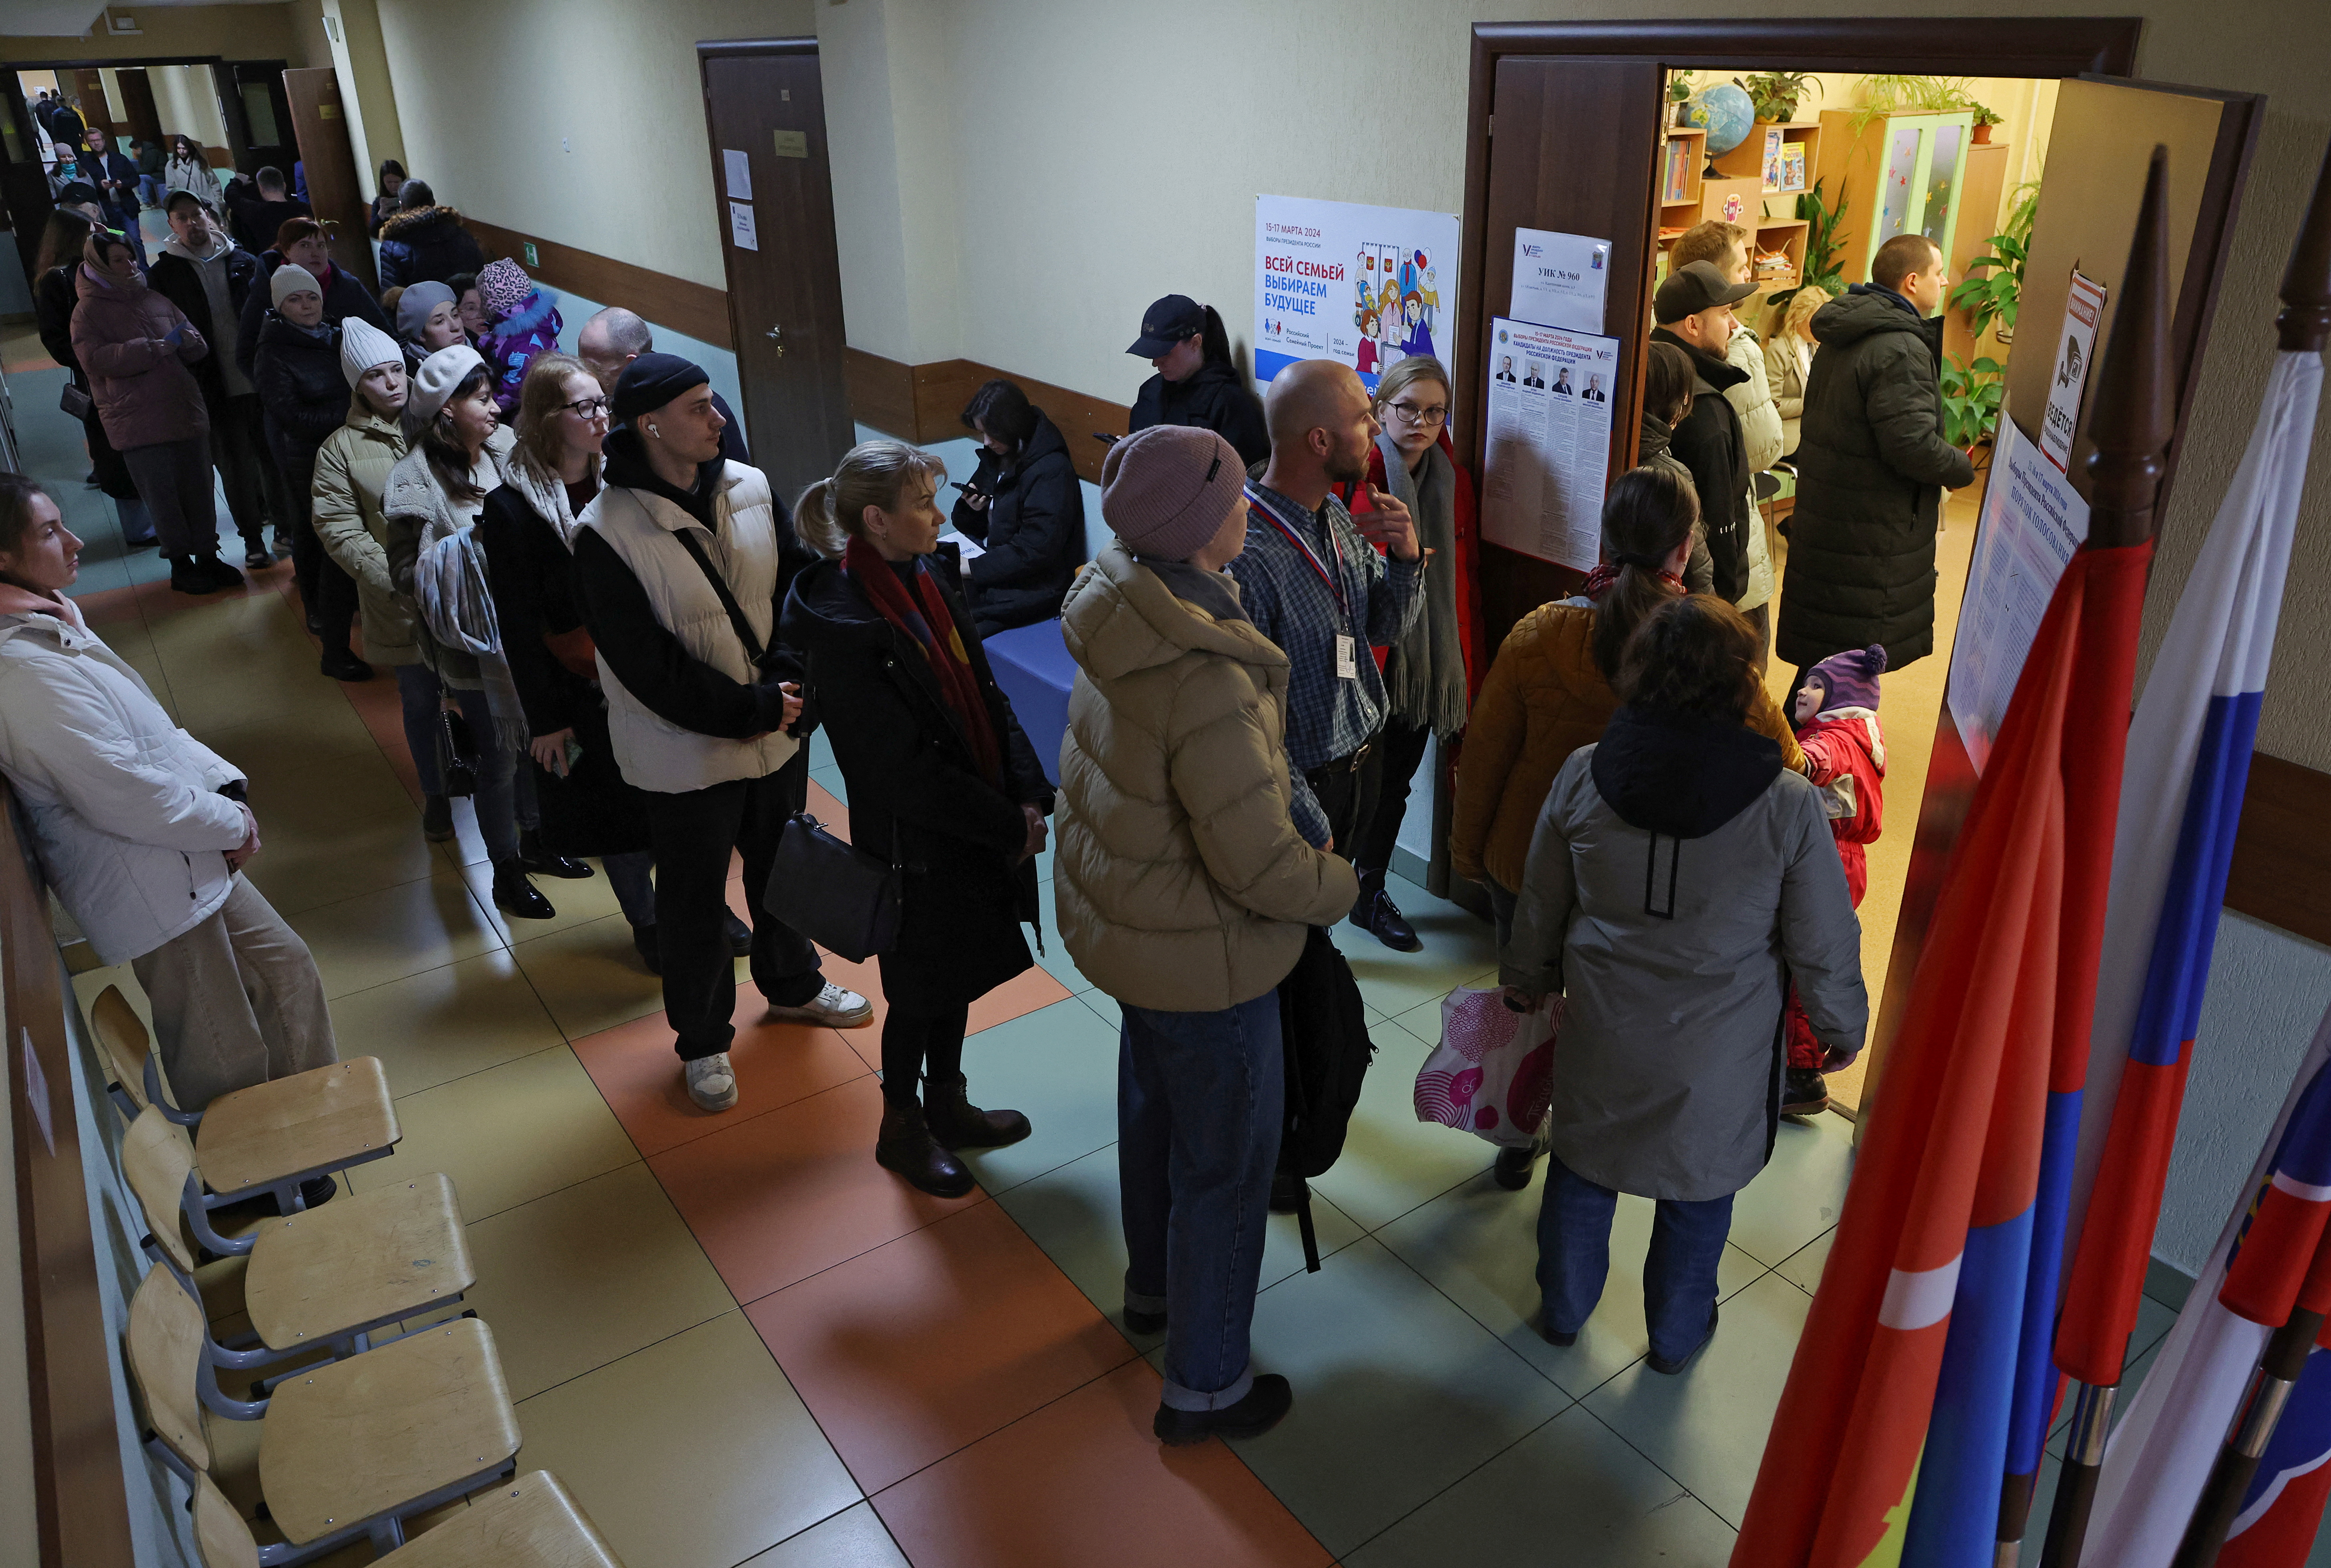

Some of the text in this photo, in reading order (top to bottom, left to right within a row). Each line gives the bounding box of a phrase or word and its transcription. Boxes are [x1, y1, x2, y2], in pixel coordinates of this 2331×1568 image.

[1266, 223, 1320, 238] 15-17 МАРТА 2024
[1281, 238, 1303, 246] ПРЕЗИДЕНТА
[1266, 255, 1344, 281] ВСЕЙ СЕМЬЕЙ
[1538, 267, 1580, 281] УИК № 960
[1265, 274, 1327, 298] ВЫБИРАЕМ
[1265, 293, 1315, 316] БУДУЩЕЕ
[2070, 298, 2094, 323] ВНИМАНИЕ!
[1286, 328, 1309, 338] Российский
[1286, 337, 1323, 350] Семейный Проект
[1514, 341, 1536, 350] КАНДИДАТЫ
[1542, 346, 1565, 355] ДОЛЖНОСТЬ
[1566, 351, 1591, 360] ПРЕЗИДЕНТА
[1528, 336, 1549, 344] ПРЕЗИДЕНТА
[1549, 340, 1571, 348] РОССИЙСКОЙ
[1572, 344, 1592, 352] ФЕДЕРАЦИИ
[1526, 350, 1576, 364] РОССИЙСКОЙ ФЕДЕРАЦИИ
[2047, 401, 2073, 438] ВЕДЁТСЯ
[2009, 456, 2022, 480] Выборы
[2021, 470, 2041, 503] Президента
[2041, 493, 2063, 528] Российской
[2038, 472, 2043, 482] 17
[2042, 478, 2053, 494] марта
[2011, 485, 2033, 521] ПОРЯДОК
[2032, 511, 2069, 567] ГОЛОСОВАНИЯ
